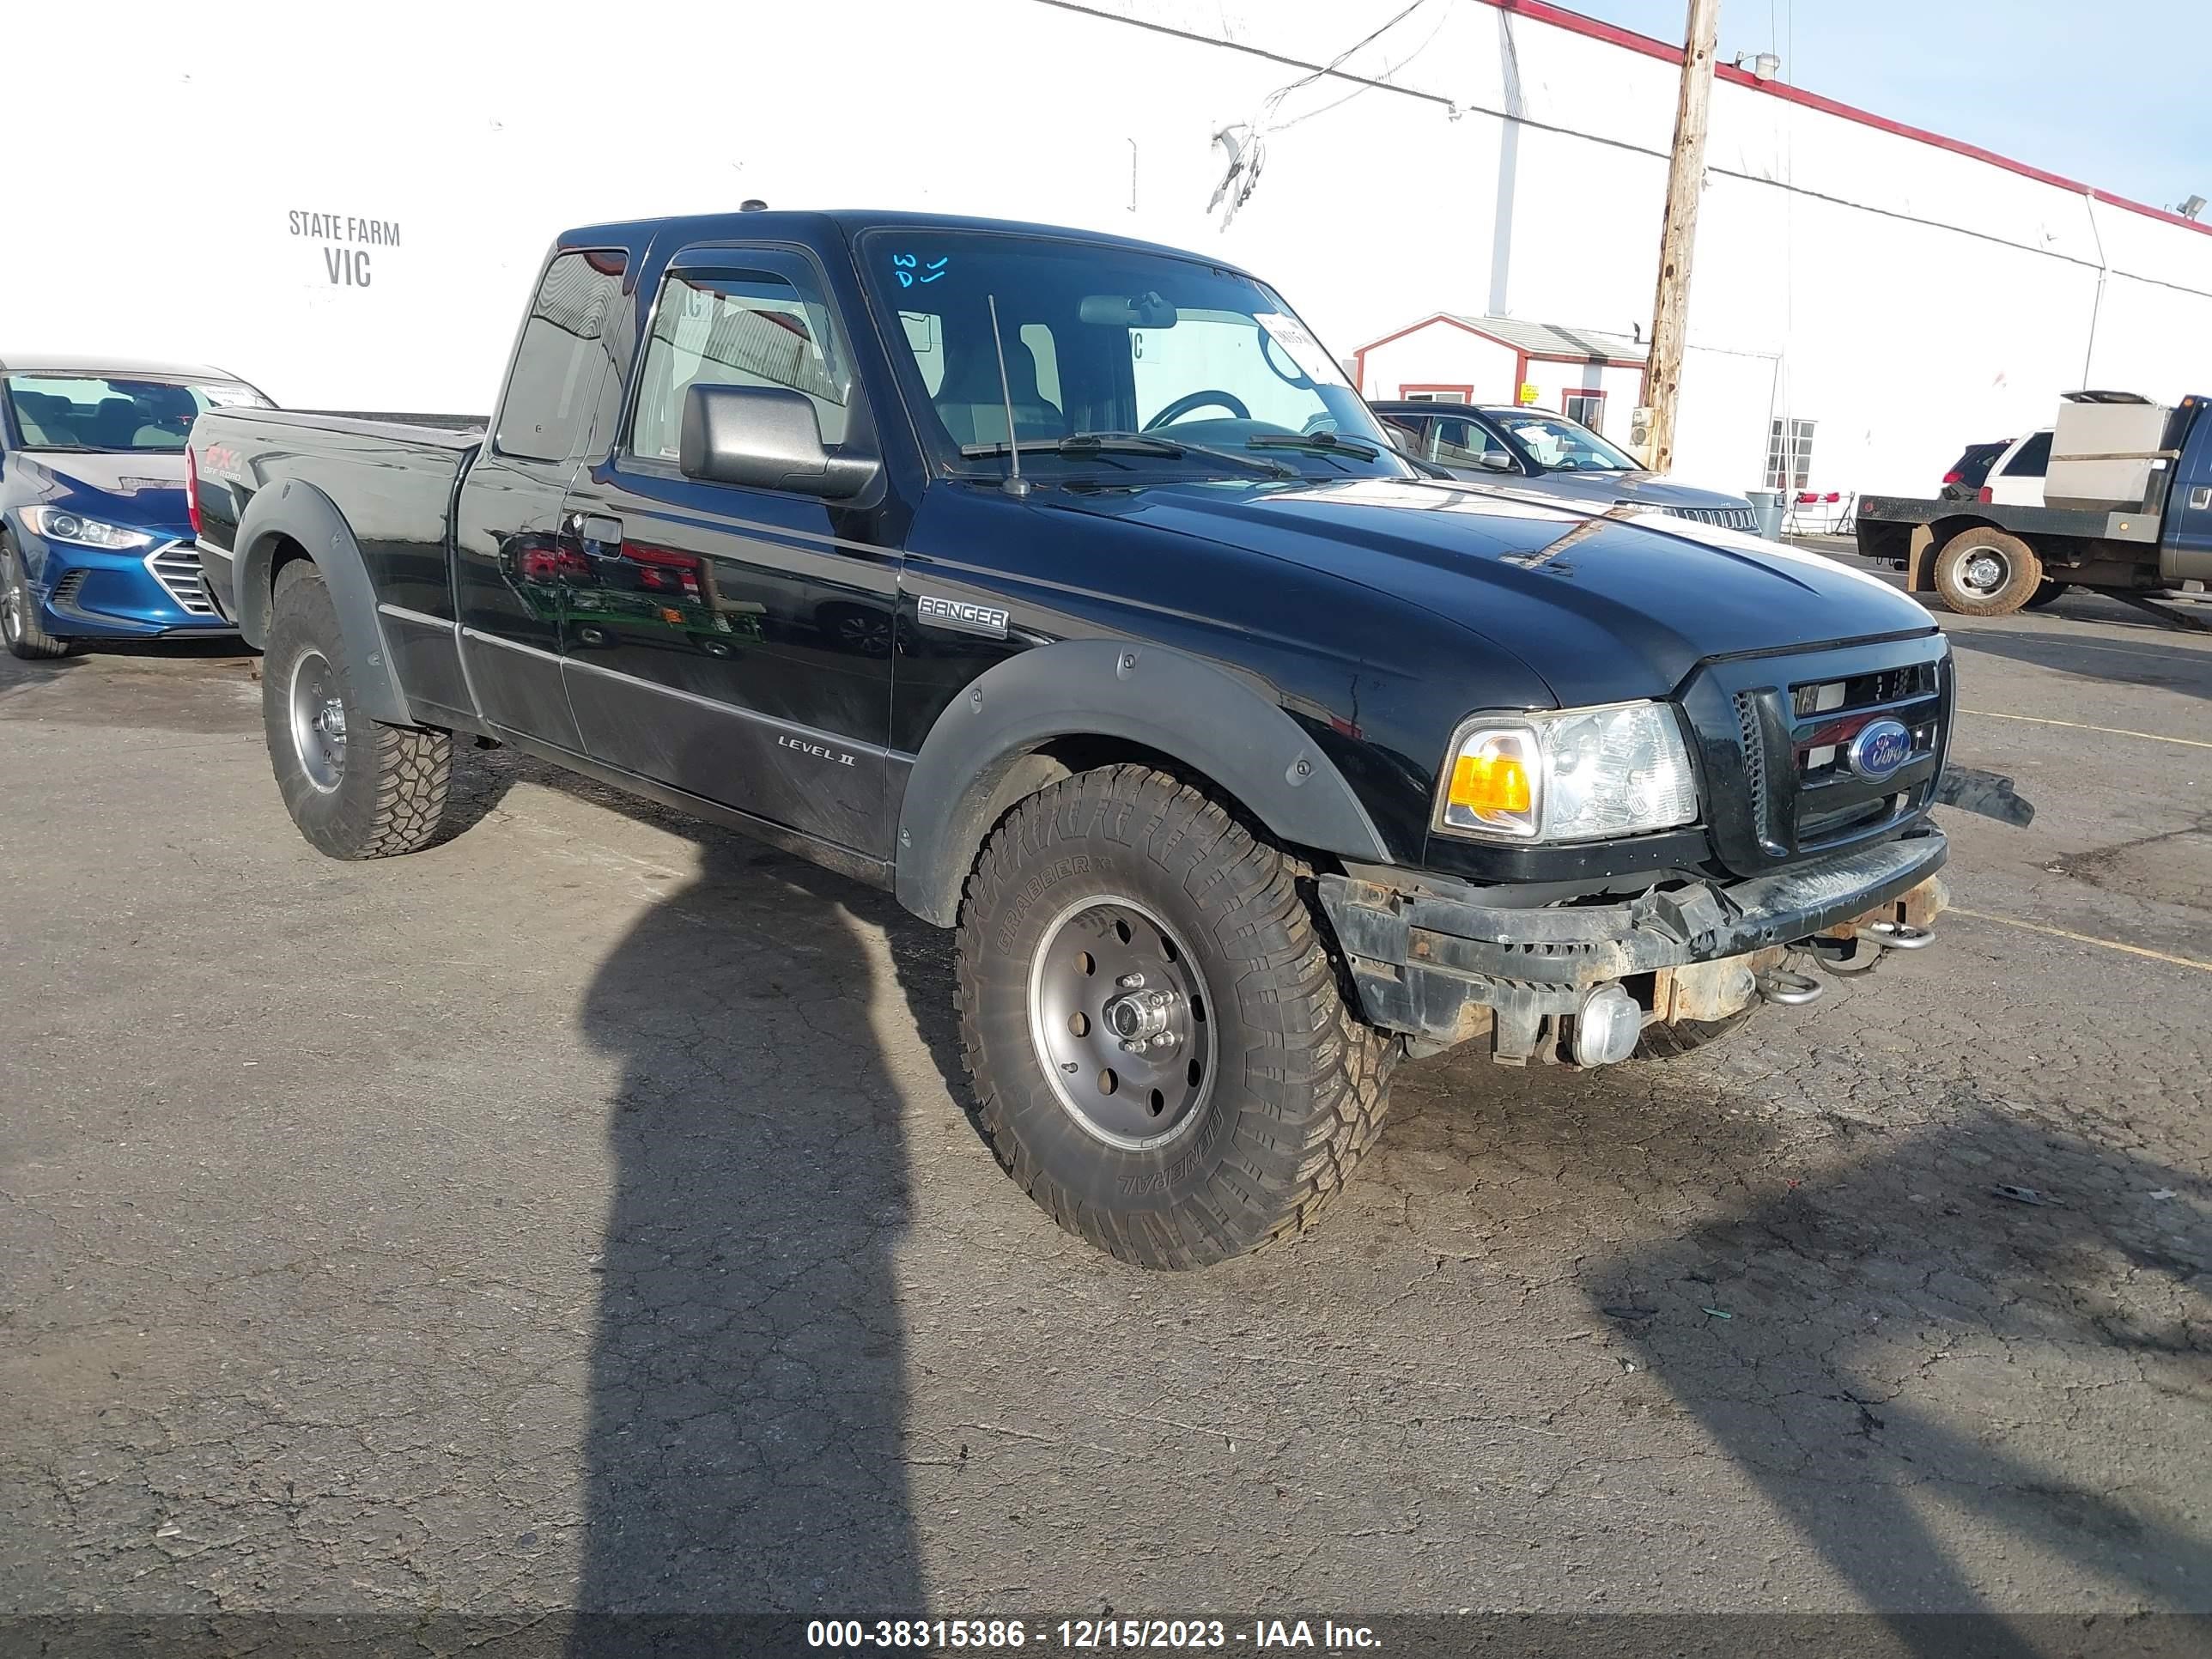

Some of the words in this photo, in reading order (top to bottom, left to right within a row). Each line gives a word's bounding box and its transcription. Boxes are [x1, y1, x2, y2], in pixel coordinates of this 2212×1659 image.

[289, 210, 343, 240] STATE
[347, 216, 400, 247] FARM
[324, 246, 371, 288] VIC
[204, 466, 219, 475] OFF
[219, 470, 241, 482] ROAD
[205, 446, 241, 471] FX4
[920, 598, 1006, 628] RANGER
[778, 736, 835, 761] LEVEL
[1873, 732, 1904, 767] Ford
[988, 856, 1091, 956] GRABBER
[1117, 1105, 1224, 1195] GENERAL
